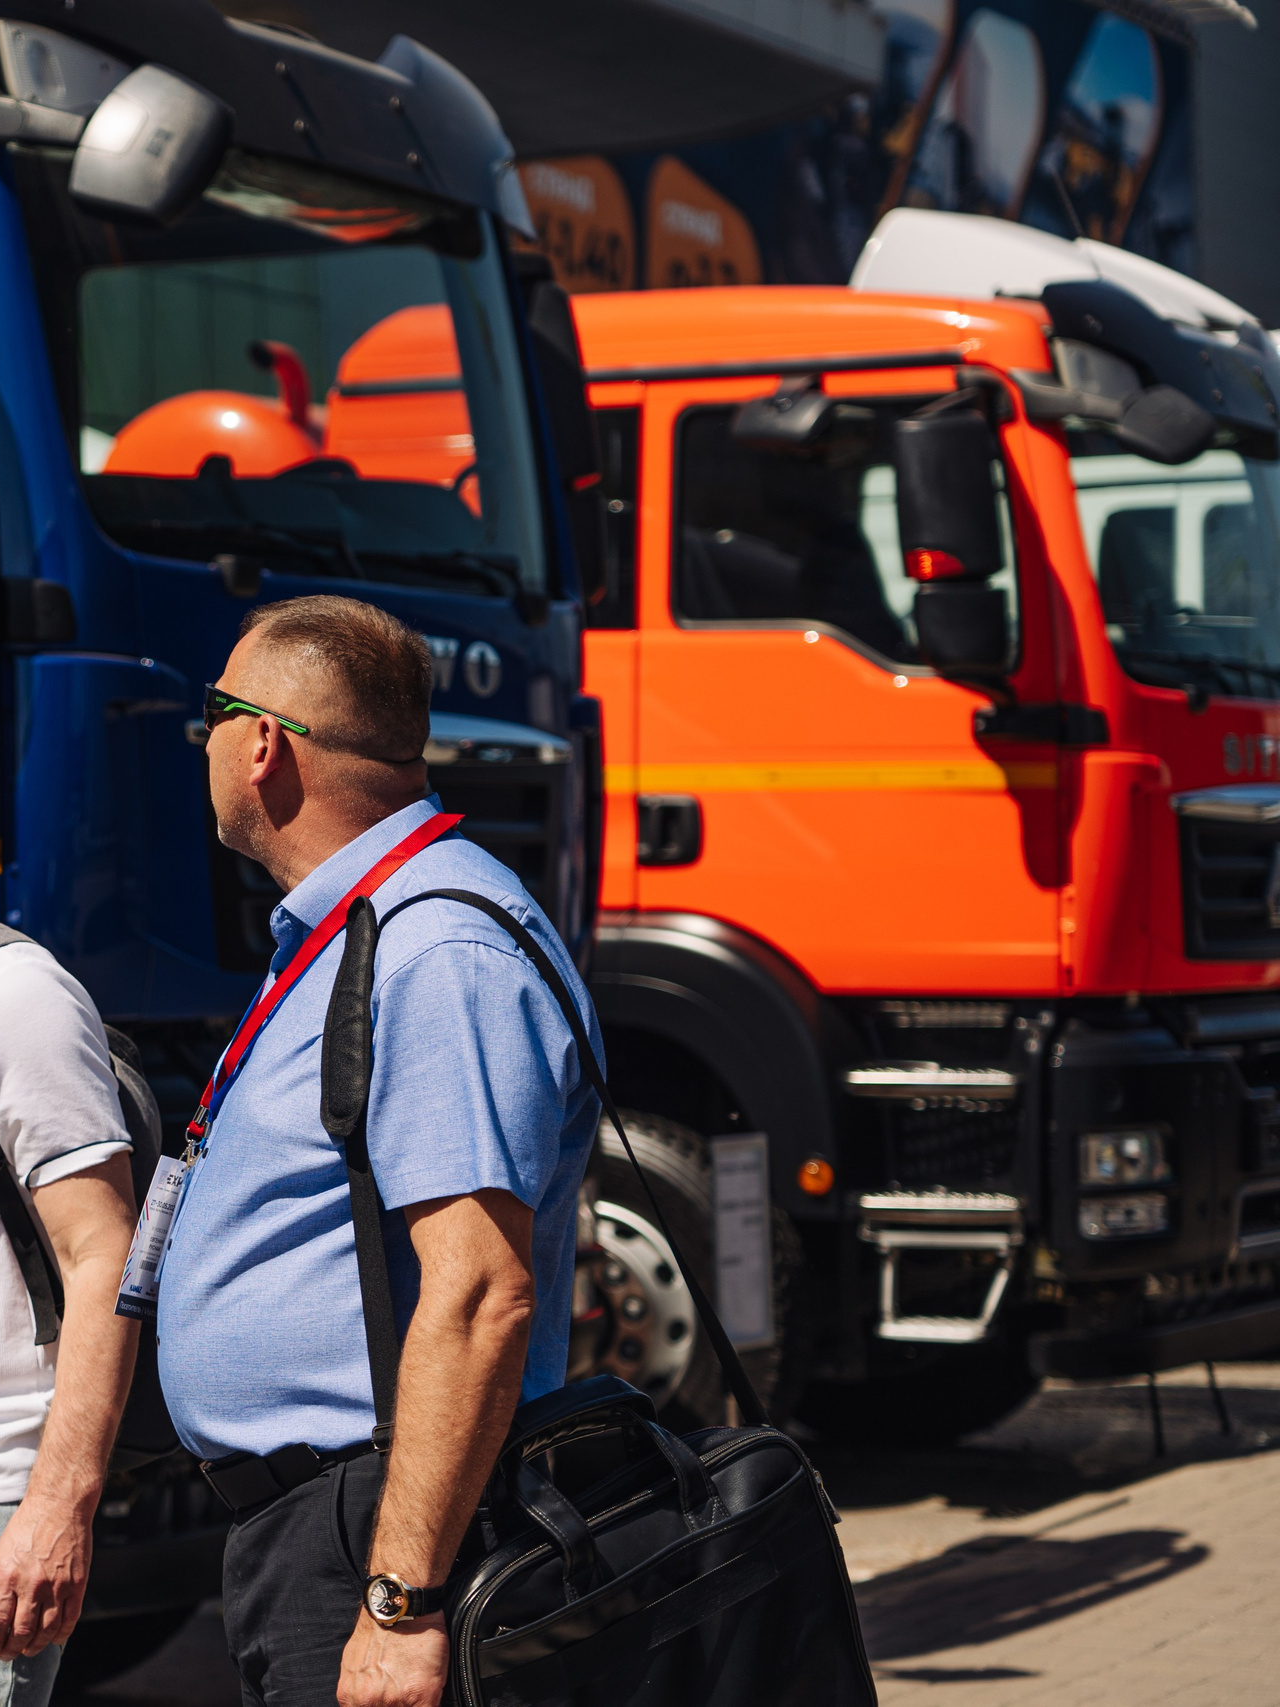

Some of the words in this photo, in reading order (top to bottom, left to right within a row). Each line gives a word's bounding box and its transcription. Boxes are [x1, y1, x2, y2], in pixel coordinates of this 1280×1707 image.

[427, 635, 502, 699] WO
[1222, 732, 1280, 777] SIT
[166, 1174, 183, 1187] EXP
